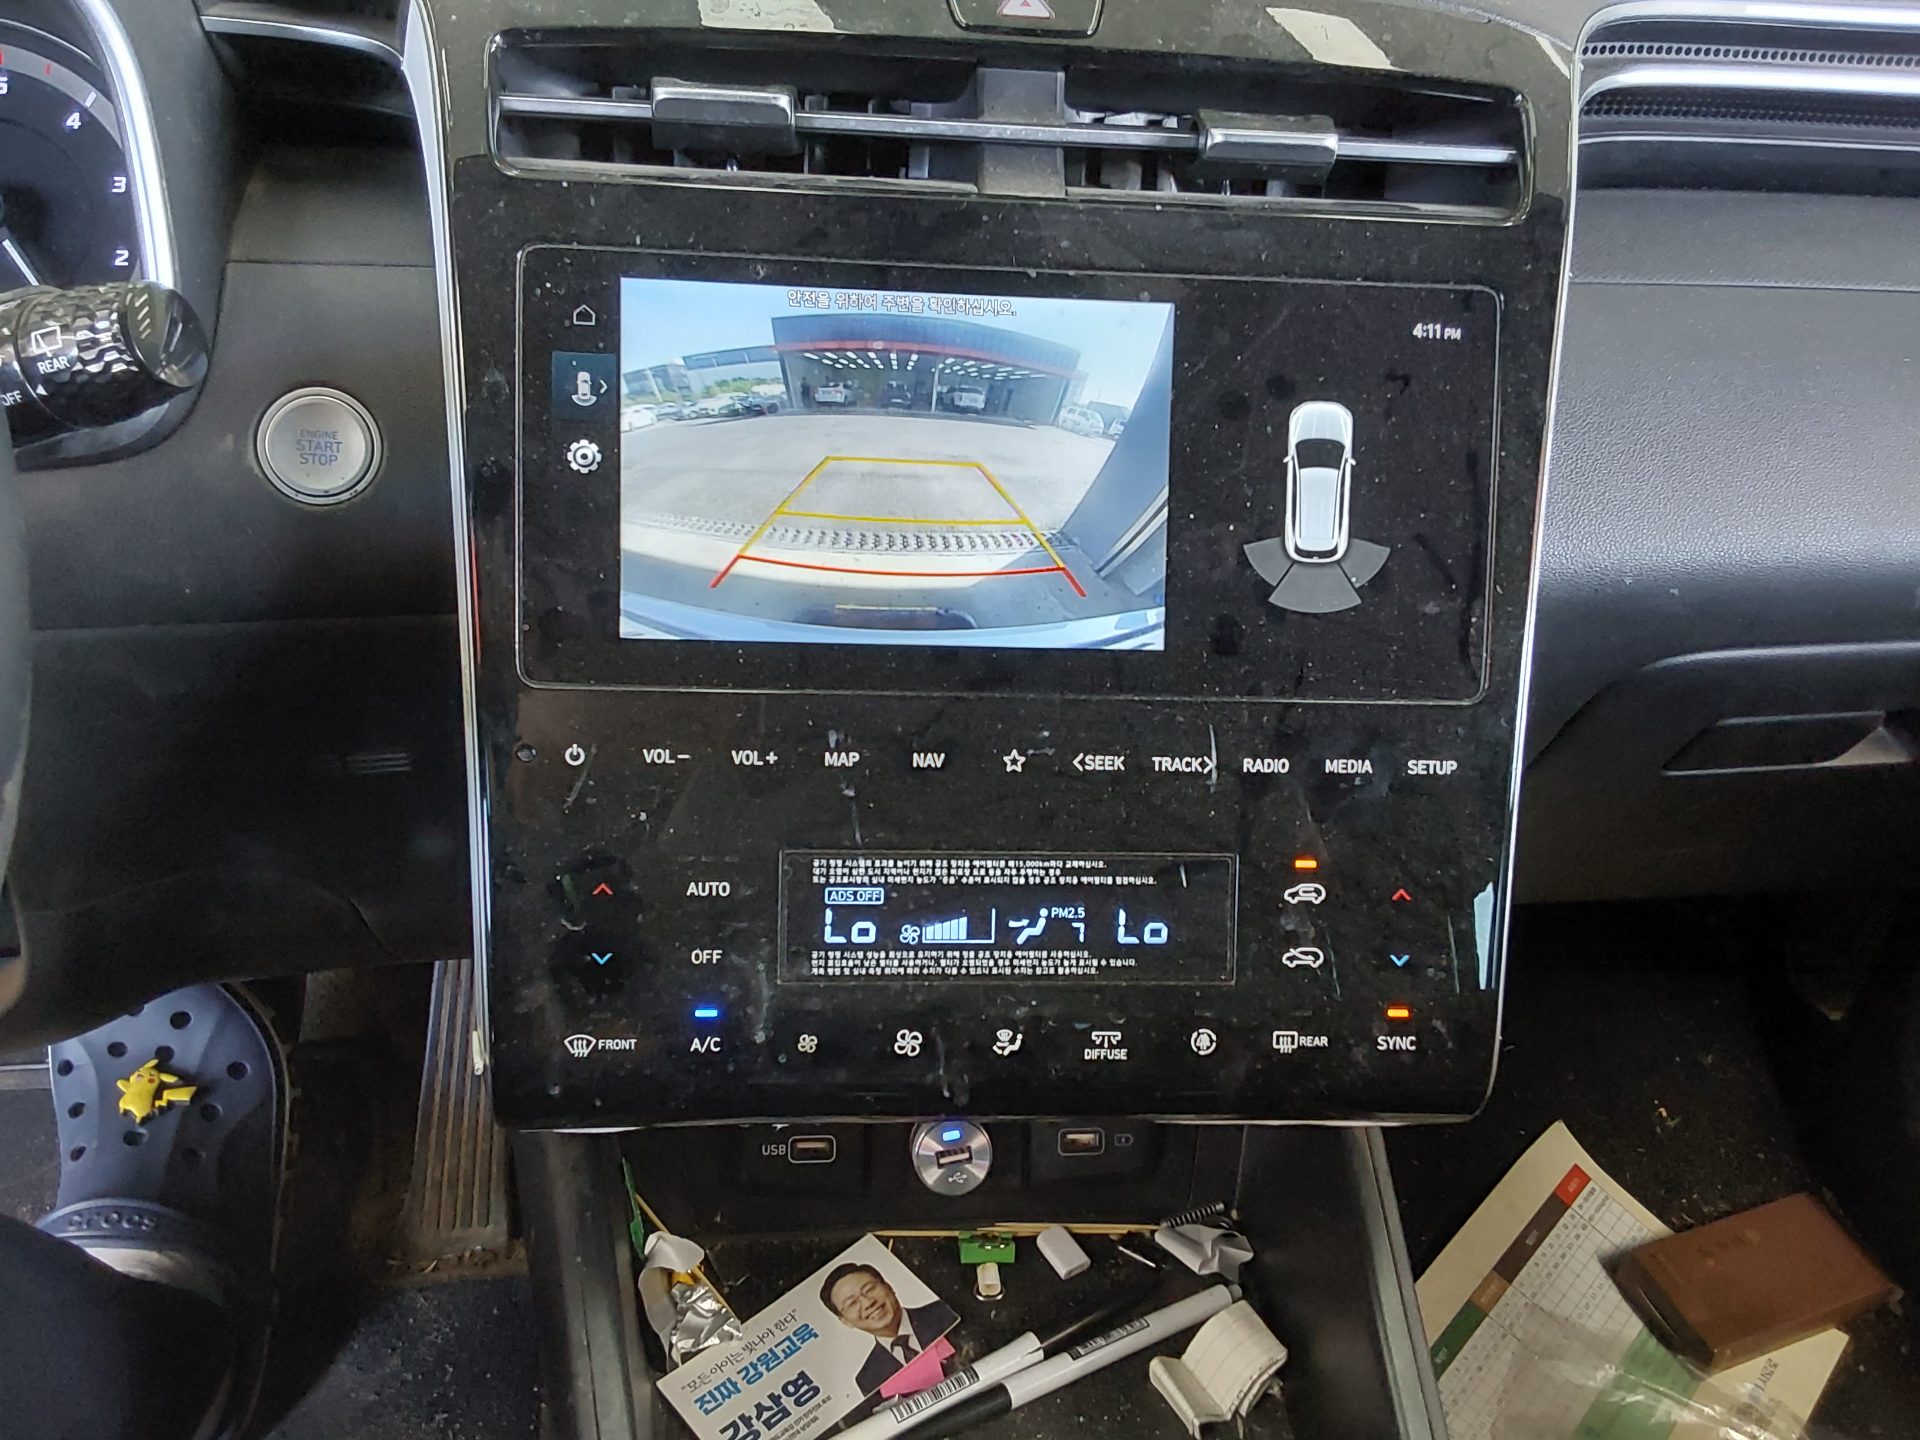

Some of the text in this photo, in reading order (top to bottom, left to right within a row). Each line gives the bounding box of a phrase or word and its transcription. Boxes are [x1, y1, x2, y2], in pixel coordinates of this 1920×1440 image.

[66, 112, 82, 129] 4
[112, 176, 127, 193] 3
[114, 249, 129, 266] 2
[787, 289, 1017, 317] 안전을 위하여 주변을 확인하십시오.
[1412, 322, 1462, 340] 4:11 PM
[37, 356, 70, 375] REAR
[300, 428, 339, 440] ENGINE
[295, 439, 343, 453] START
[299, 453, 338, 466] STOP
[731, 750, 778, 767] VOL+
[824, 751, 860, 768] MAP
[912, 752, 945, 769] NAV
[1242, 757, 1290, 774] RADIO
[1324, 758, 1373, 775] MEDIA
[1407, 760, 1458, 776] SETUP
[686, 881, 731, 897] AUTO
[829, 890, 880, 901] ADS OFF
[1051, 907, 1085, 919] PM2.5
[691, 949, 723, 964] OFF
[597, 1038, 637, 1051] FRONT
[690, 1037, 721, 1054] A/C
[1298, 1035, 1329, 1049] REAR
[1377, 1035, 1417, 1052] SYNC
[1083, 1048, 1128, 1061] DIFFUSE
[761, 1143, 787, 1157] USB
[67, 1210, 157, 1231] crocs
[693, 1322, 820, 1416] 진짜 강원교육
[719, 1370, 821, 1440] 강삼영
